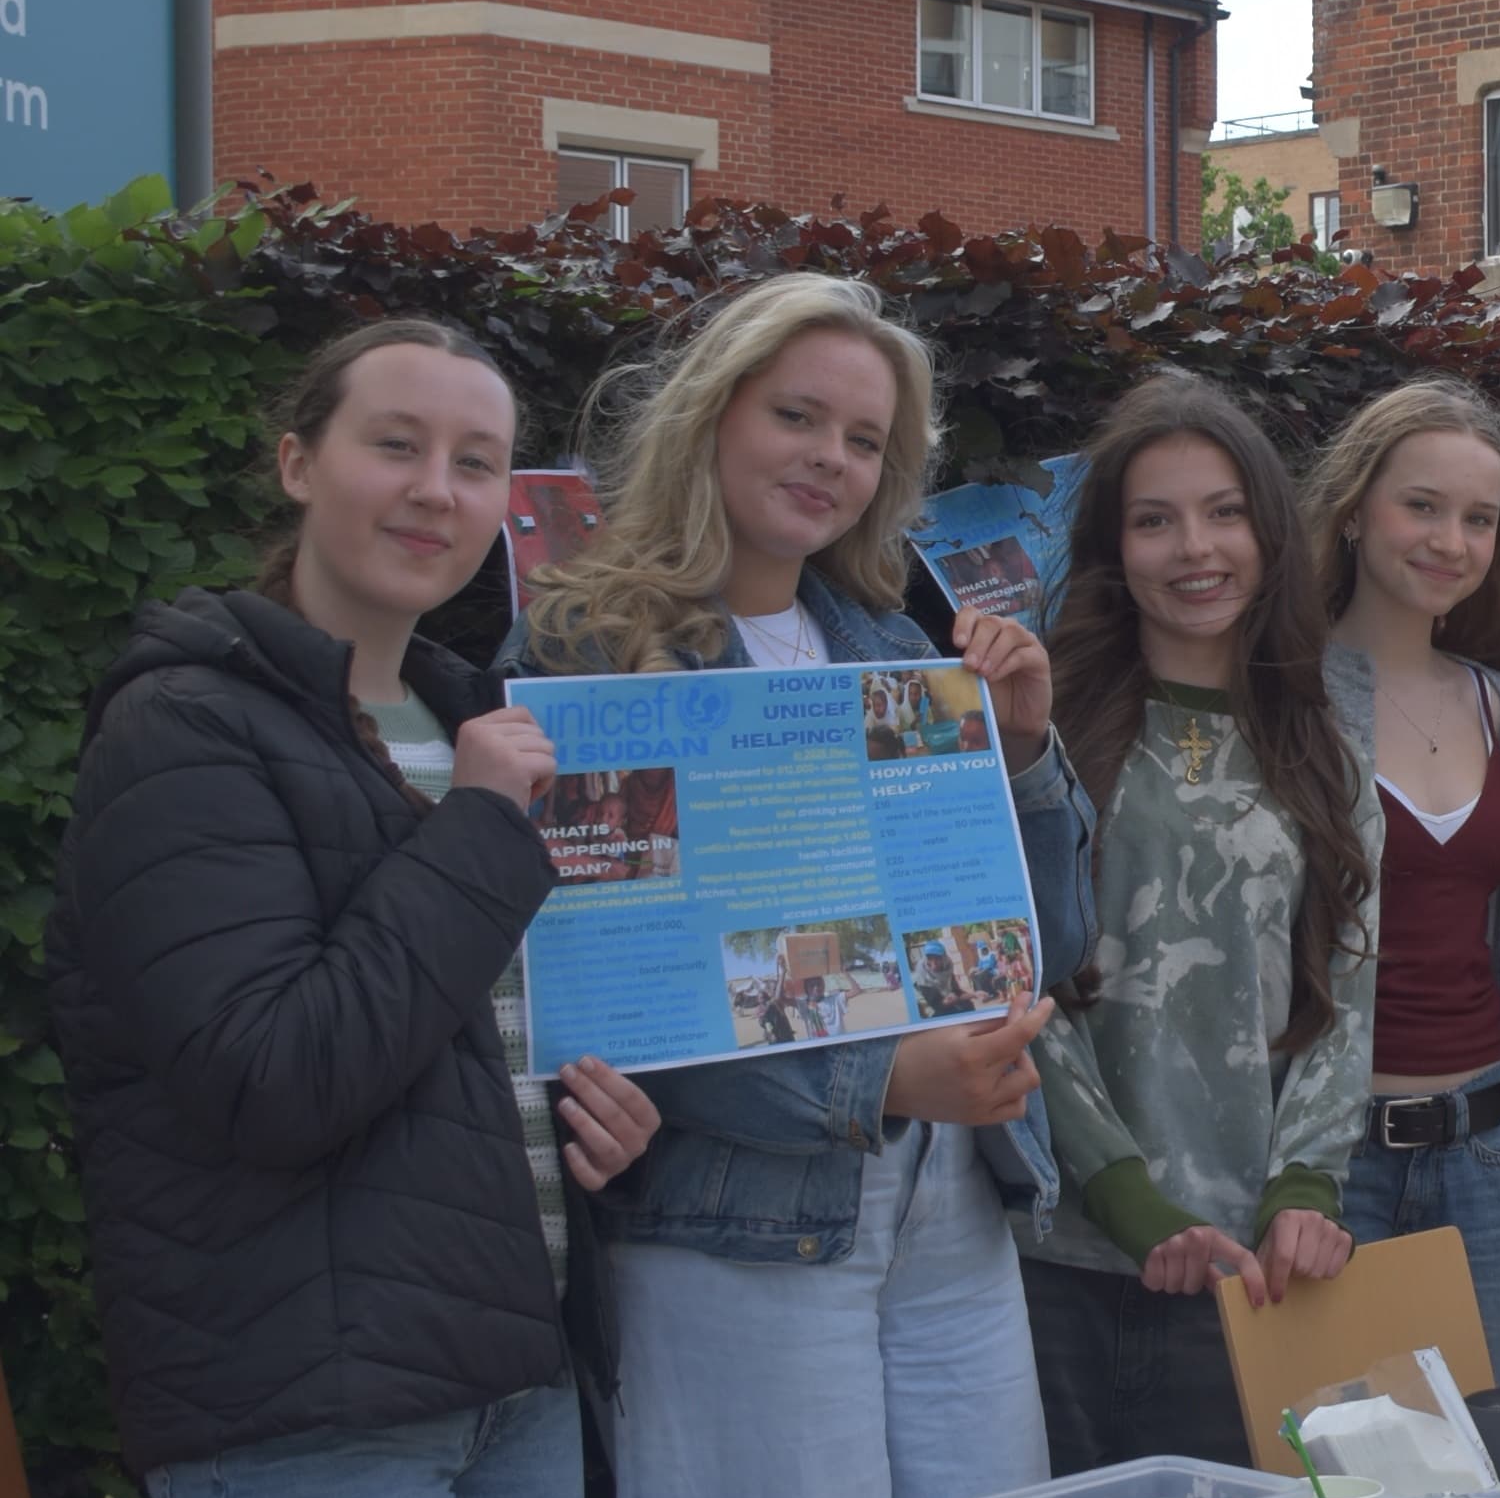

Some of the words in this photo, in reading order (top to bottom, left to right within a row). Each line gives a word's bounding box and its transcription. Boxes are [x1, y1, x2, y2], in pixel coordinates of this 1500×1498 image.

[767, 676, 826, 694] HOW
[831, 675, 853, 691] IS
[763, 701, 854, 721] UNICEF
[731, 727, 857, 750] HELPING?
[576, 736, 710, 765] SUDAN
[869, 766, 912, 780] HOW
[916, 761, 958, 775] CAN
[961, 756, 997, 770] YOU
[872, 781, 932, 798] HELP?
[592, 823, 610, 835] IS
[550, 838, 650, 858] APPENING
[651, 837, 673, 850] IN
[558, 862, 612, 877] DAN?
[628, 1035, 667, 1048] MILLION
